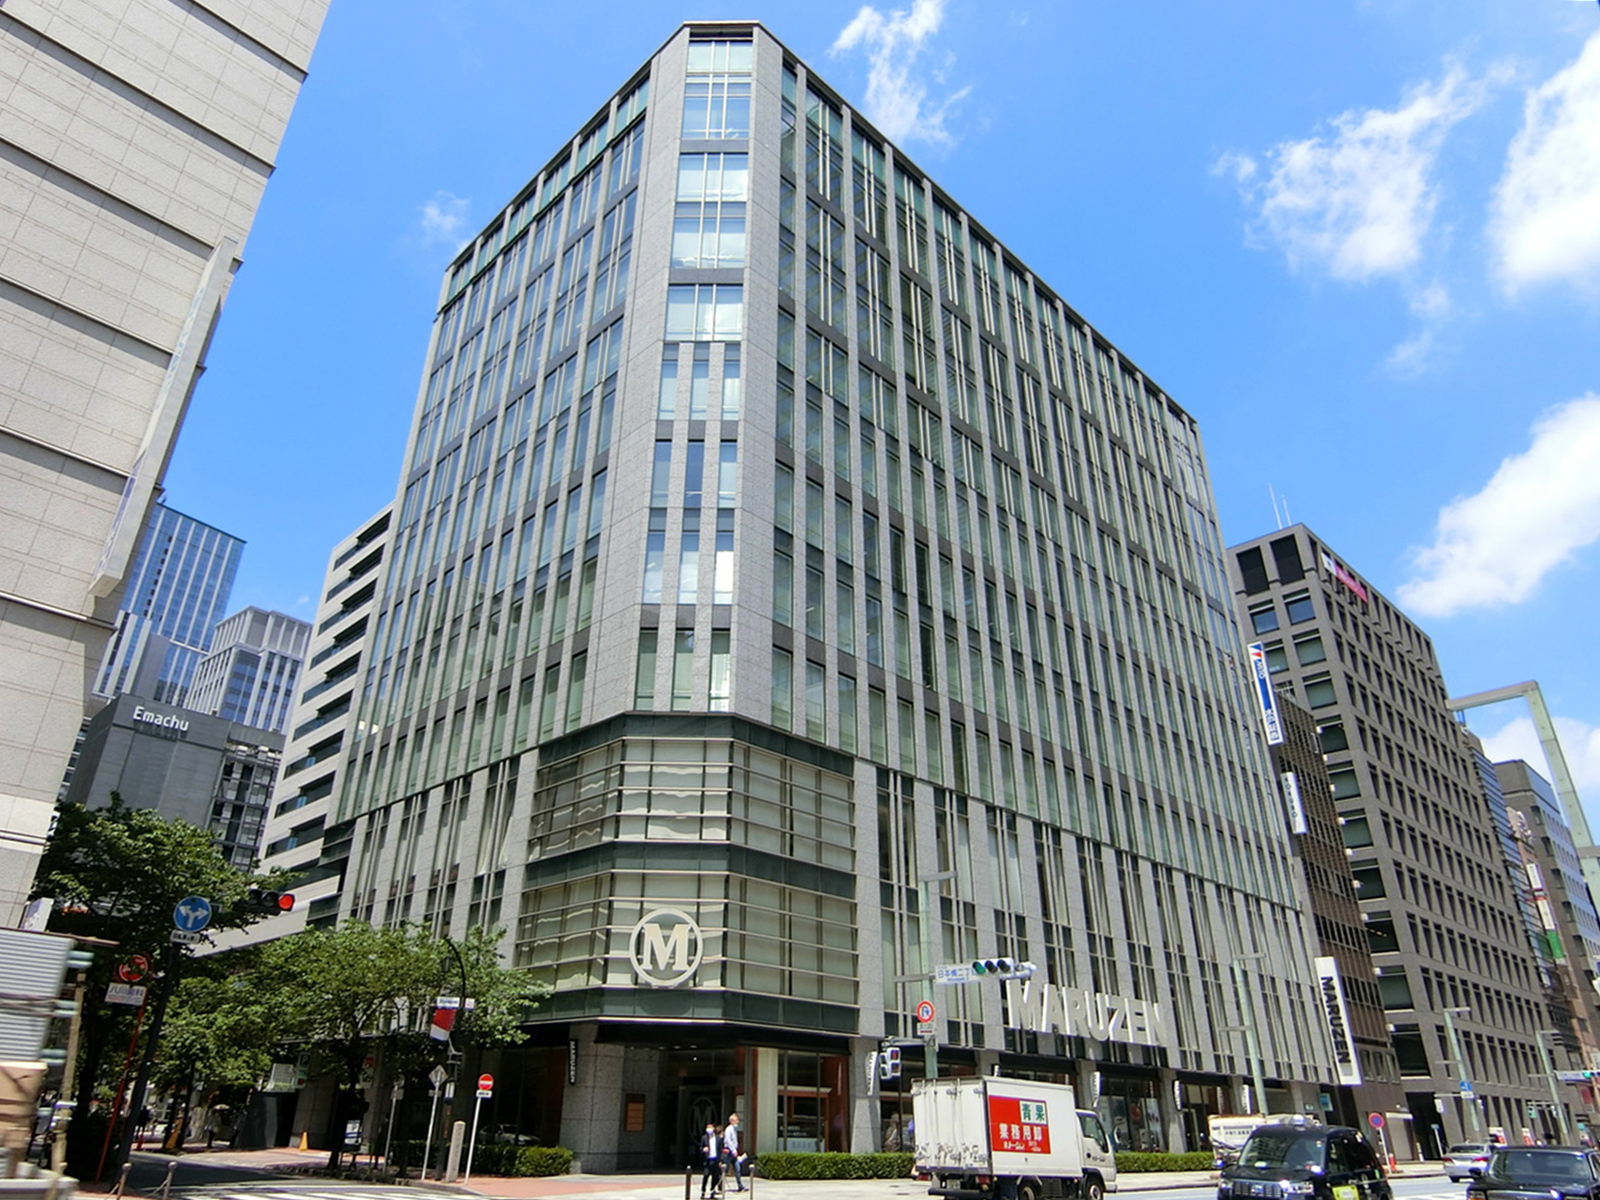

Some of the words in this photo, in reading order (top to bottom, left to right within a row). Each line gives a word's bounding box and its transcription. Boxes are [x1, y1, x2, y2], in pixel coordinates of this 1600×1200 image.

[133, 705, 189, 731] Emachu
[640, 923, 691, 971] M
[1006, 979, 1167, 1047] MARUZEN
[1321, 976, 1351, 1063] MARUZEN
[1022, 1103, 1045, 1121] 青果
[999, 1123, 1042, 1141] 業務用卸
